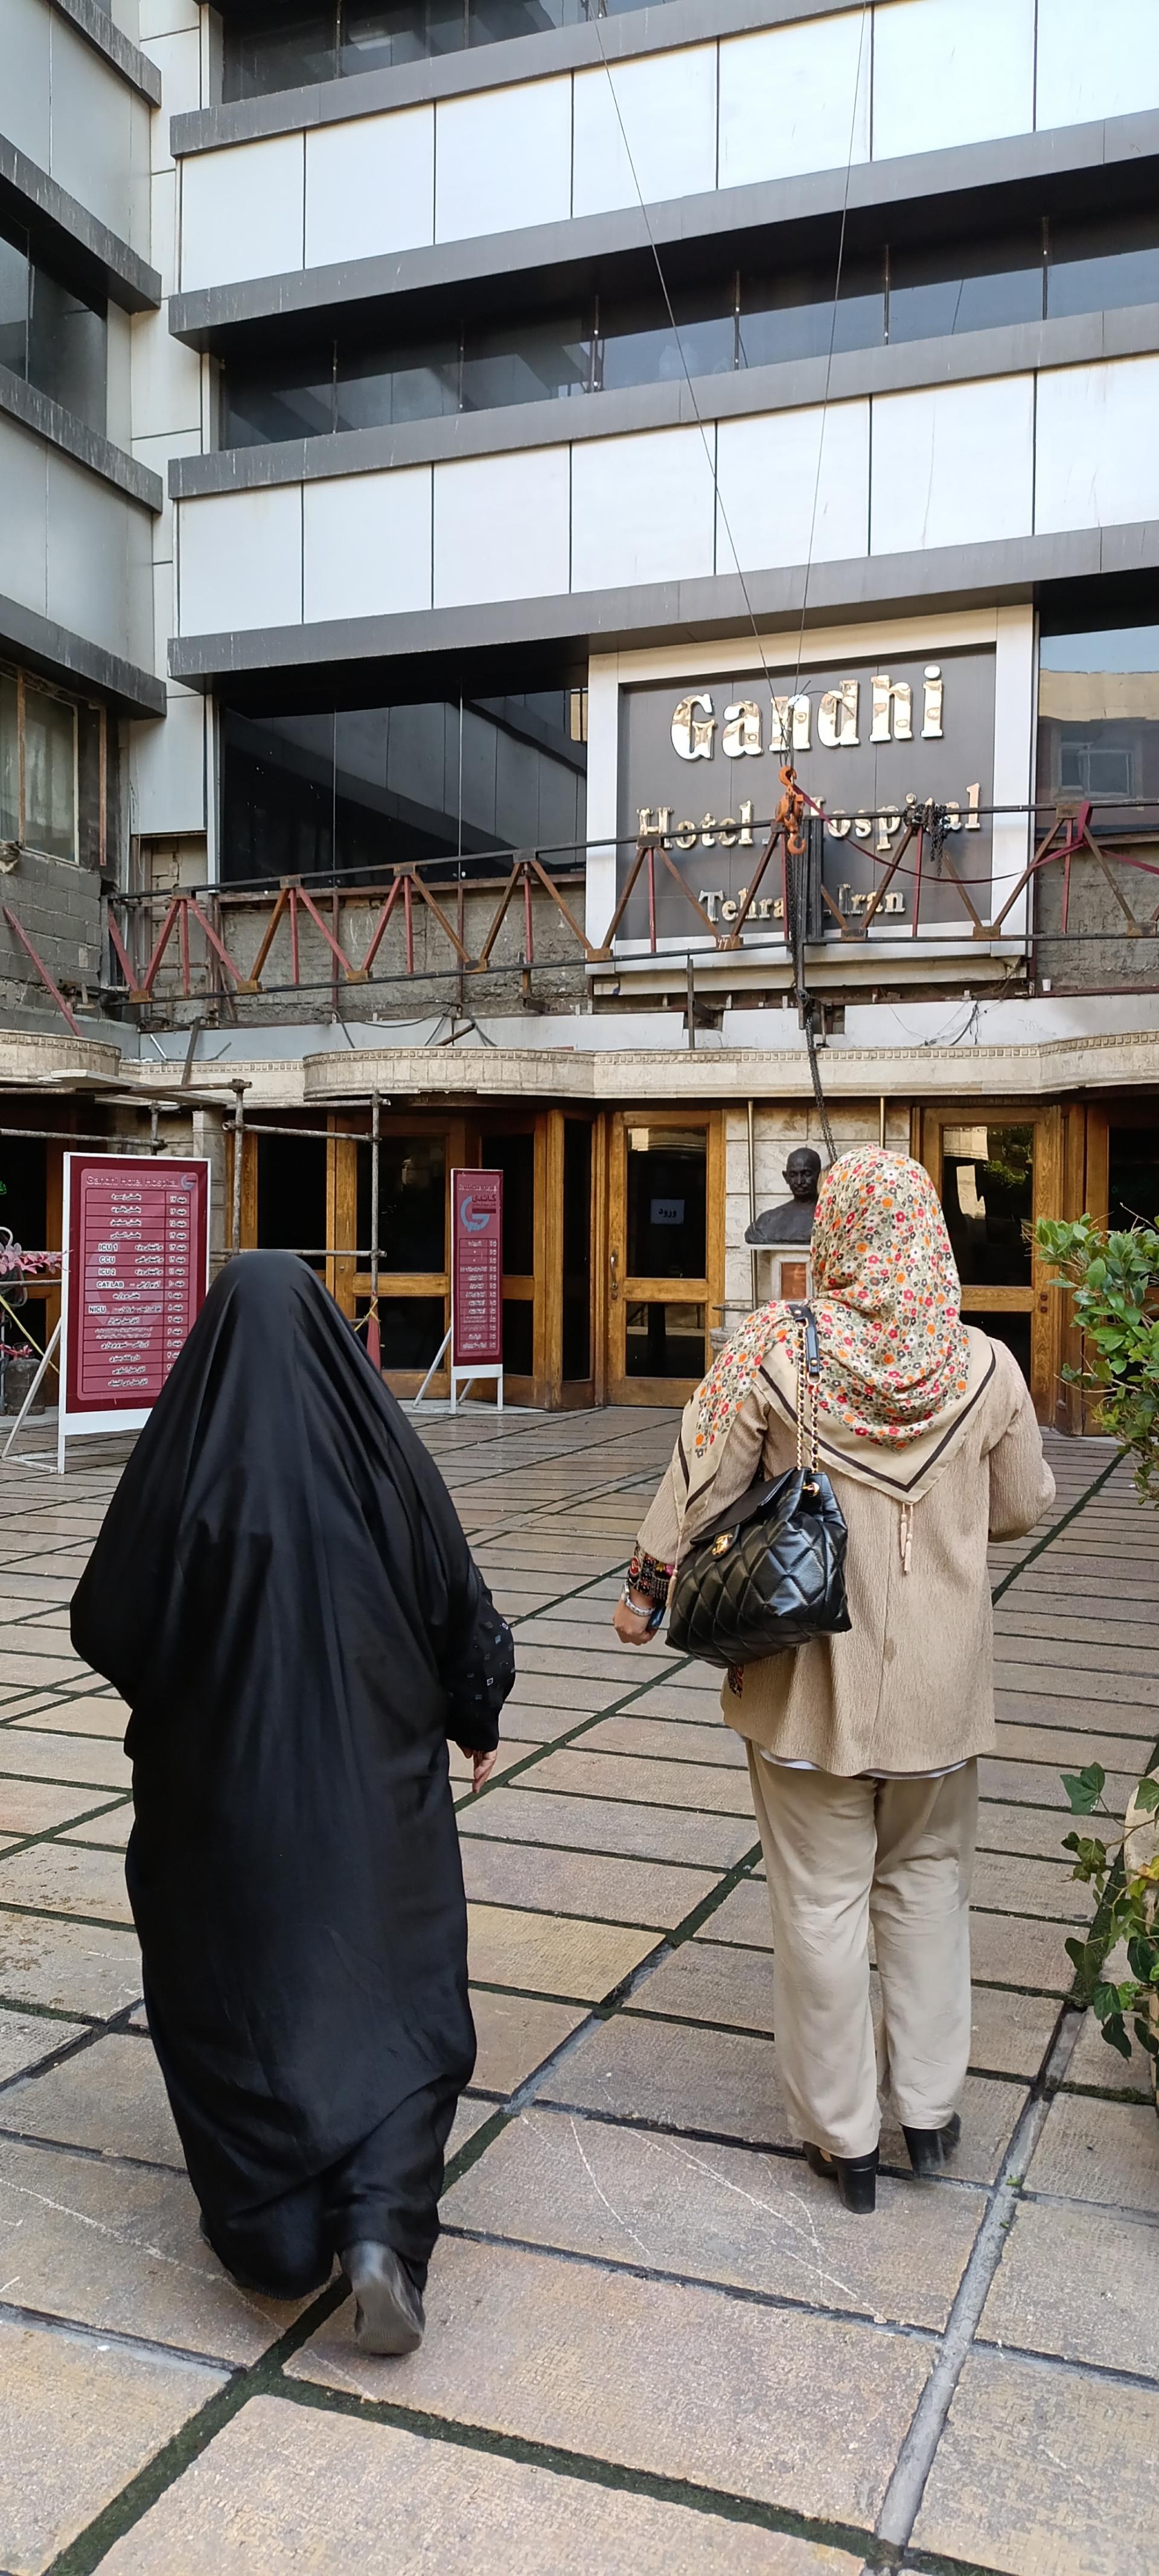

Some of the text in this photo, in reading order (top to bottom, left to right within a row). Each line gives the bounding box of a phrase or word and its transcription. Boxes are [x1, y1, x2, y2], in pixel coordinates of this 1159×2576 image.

[671, 665, 944, 760] Gandhi
[636, 800, 753, 850] Hotel
[698, 887, 784, 922] Tehra
[658, 1208, 677, 1218] ورود
[89, 1305, 106, 1313] NICU
